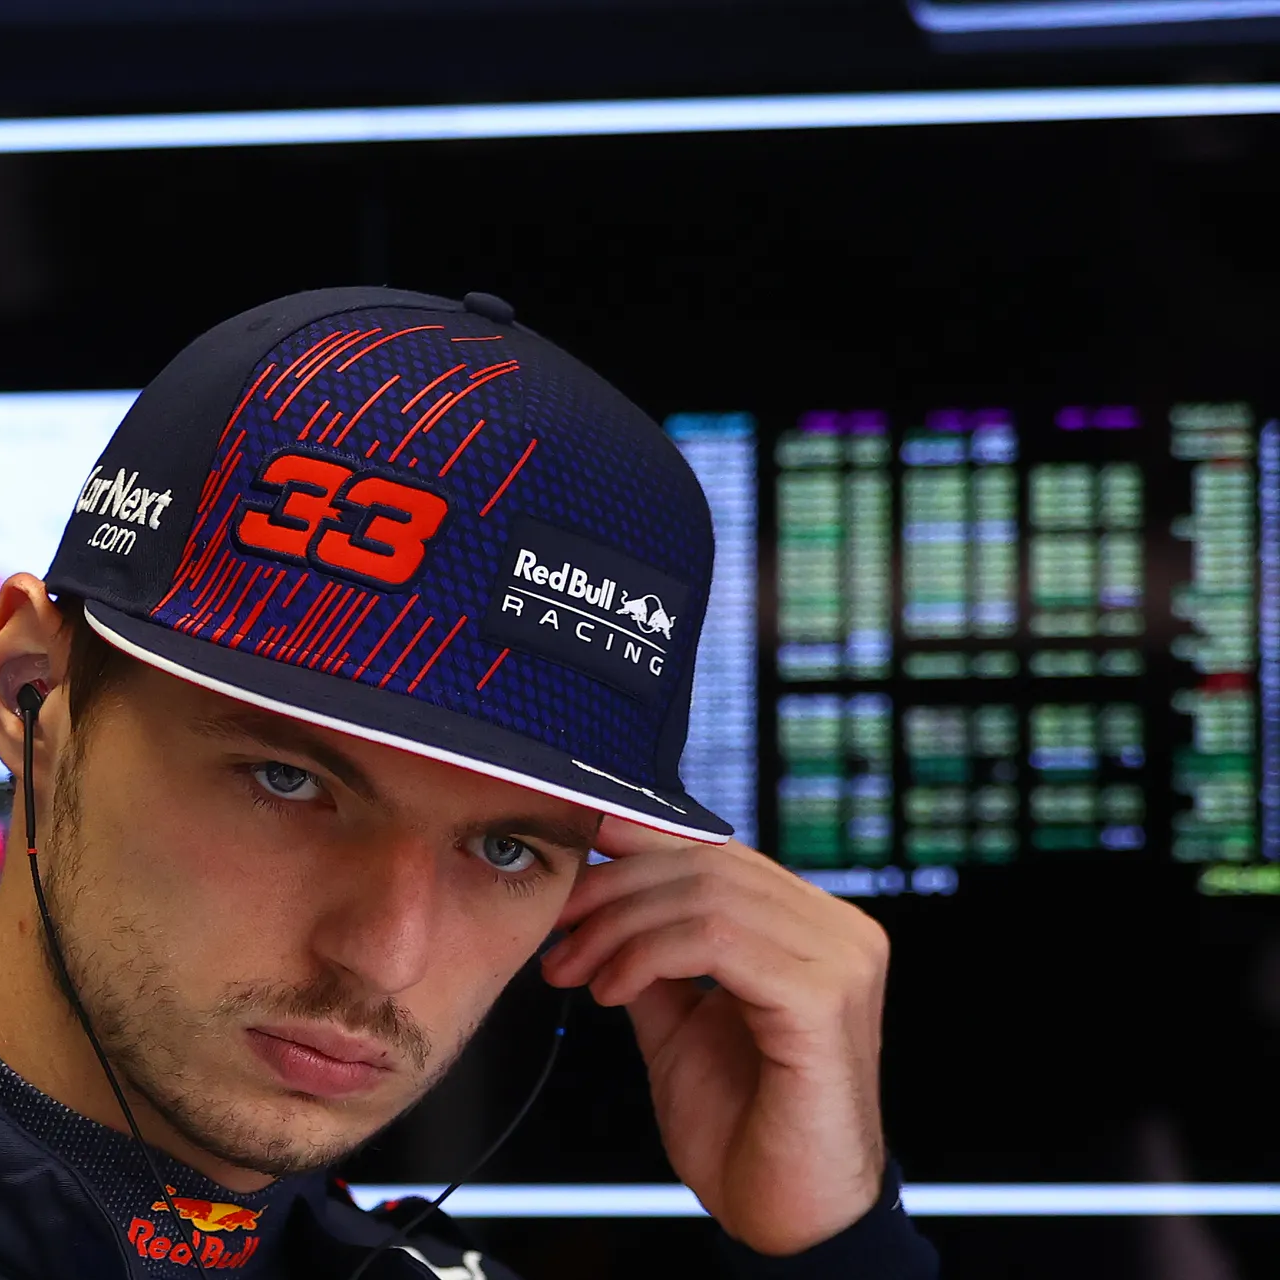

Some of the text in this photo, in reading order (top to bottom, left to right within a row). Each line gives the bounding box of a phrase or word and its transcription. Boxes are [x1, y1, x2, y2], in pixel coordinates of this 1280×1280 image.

[87, 522, 137, 555] .com
[237, 452, 448, 584] 33
[501, 594, 665, 677] RACING
[127, 1216, 262, 1269] Red Bull
